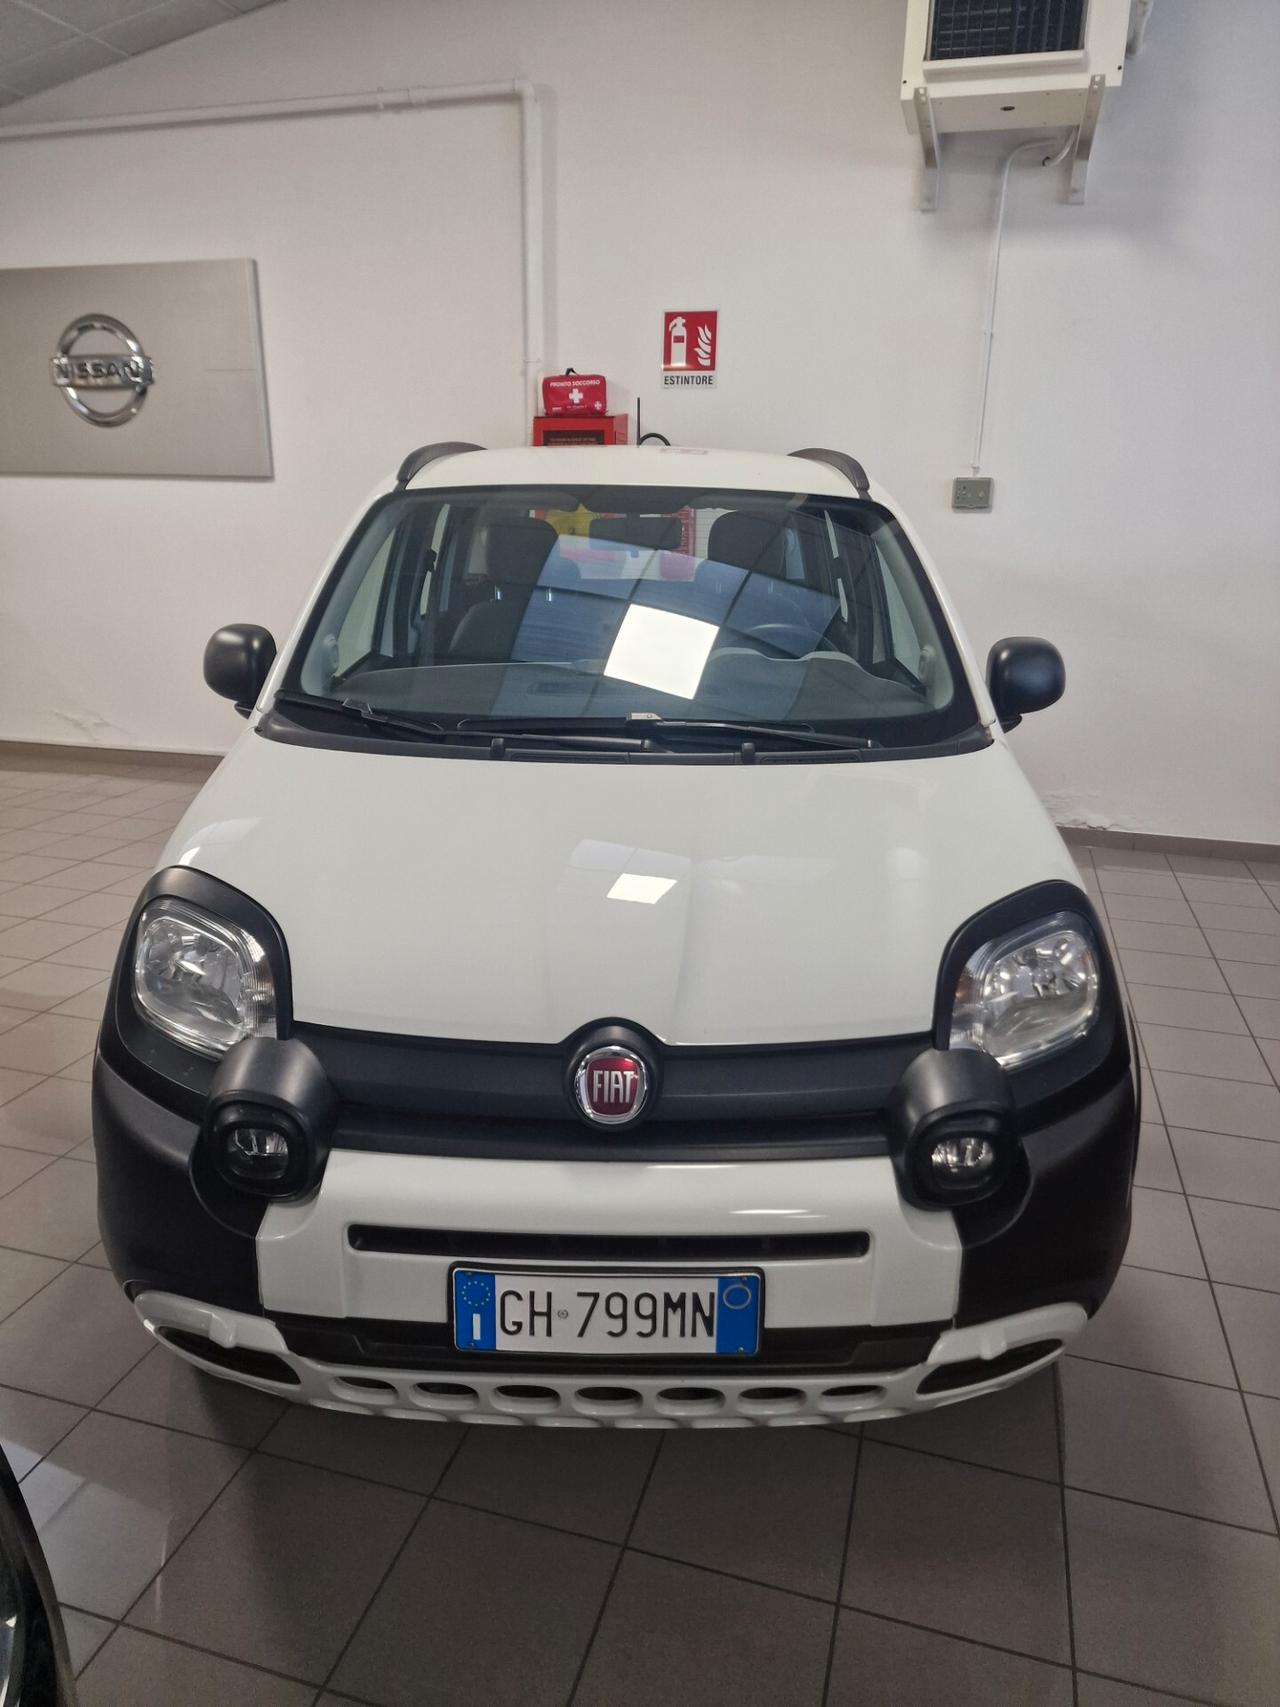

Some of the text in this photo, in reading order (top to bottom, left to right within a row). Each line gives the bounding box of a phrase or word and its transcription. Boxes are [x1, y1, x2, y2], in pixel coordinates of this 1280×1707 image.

[54, 358, 145, 383] NISSAN
[572, 379, 600, 387] SOCCORSO
[664, 375, 713, 385] ESTINTORE
[592, 1070, 635, 1104] FIAT
